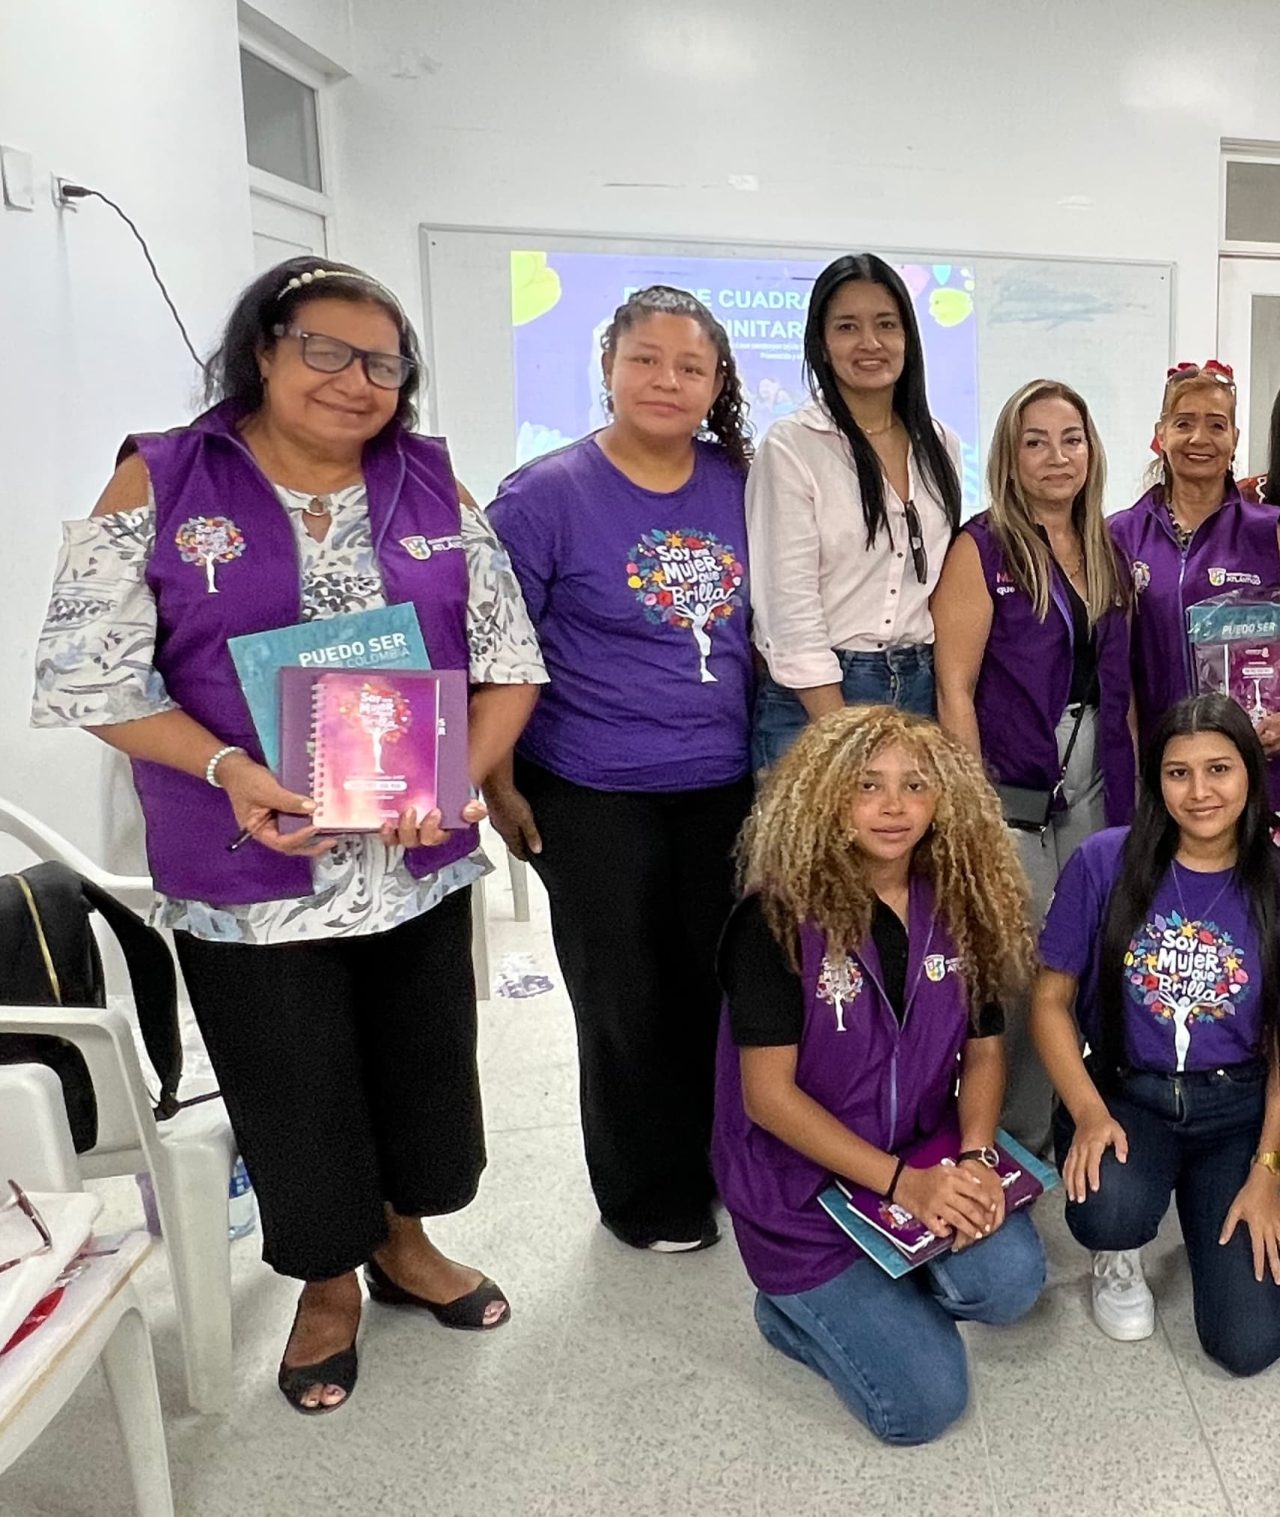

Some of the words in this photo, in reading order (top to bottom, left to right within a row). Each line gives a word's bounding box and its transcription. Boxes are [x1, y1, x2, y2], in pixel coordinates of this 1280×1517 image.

[655, 545, 690, 561] Soy
[671, 582, 735, 606] Brilla
[1222, 623, 1255, 635] PUEDO
[1256, 622, 1276, 633] SER
[299, 641, 365, 668] PUEDO
[368, 632, 408, 653] SER
[1161, 929, 1198, 953] Soy
[1159, 974, 1230, 1002] Brilla
